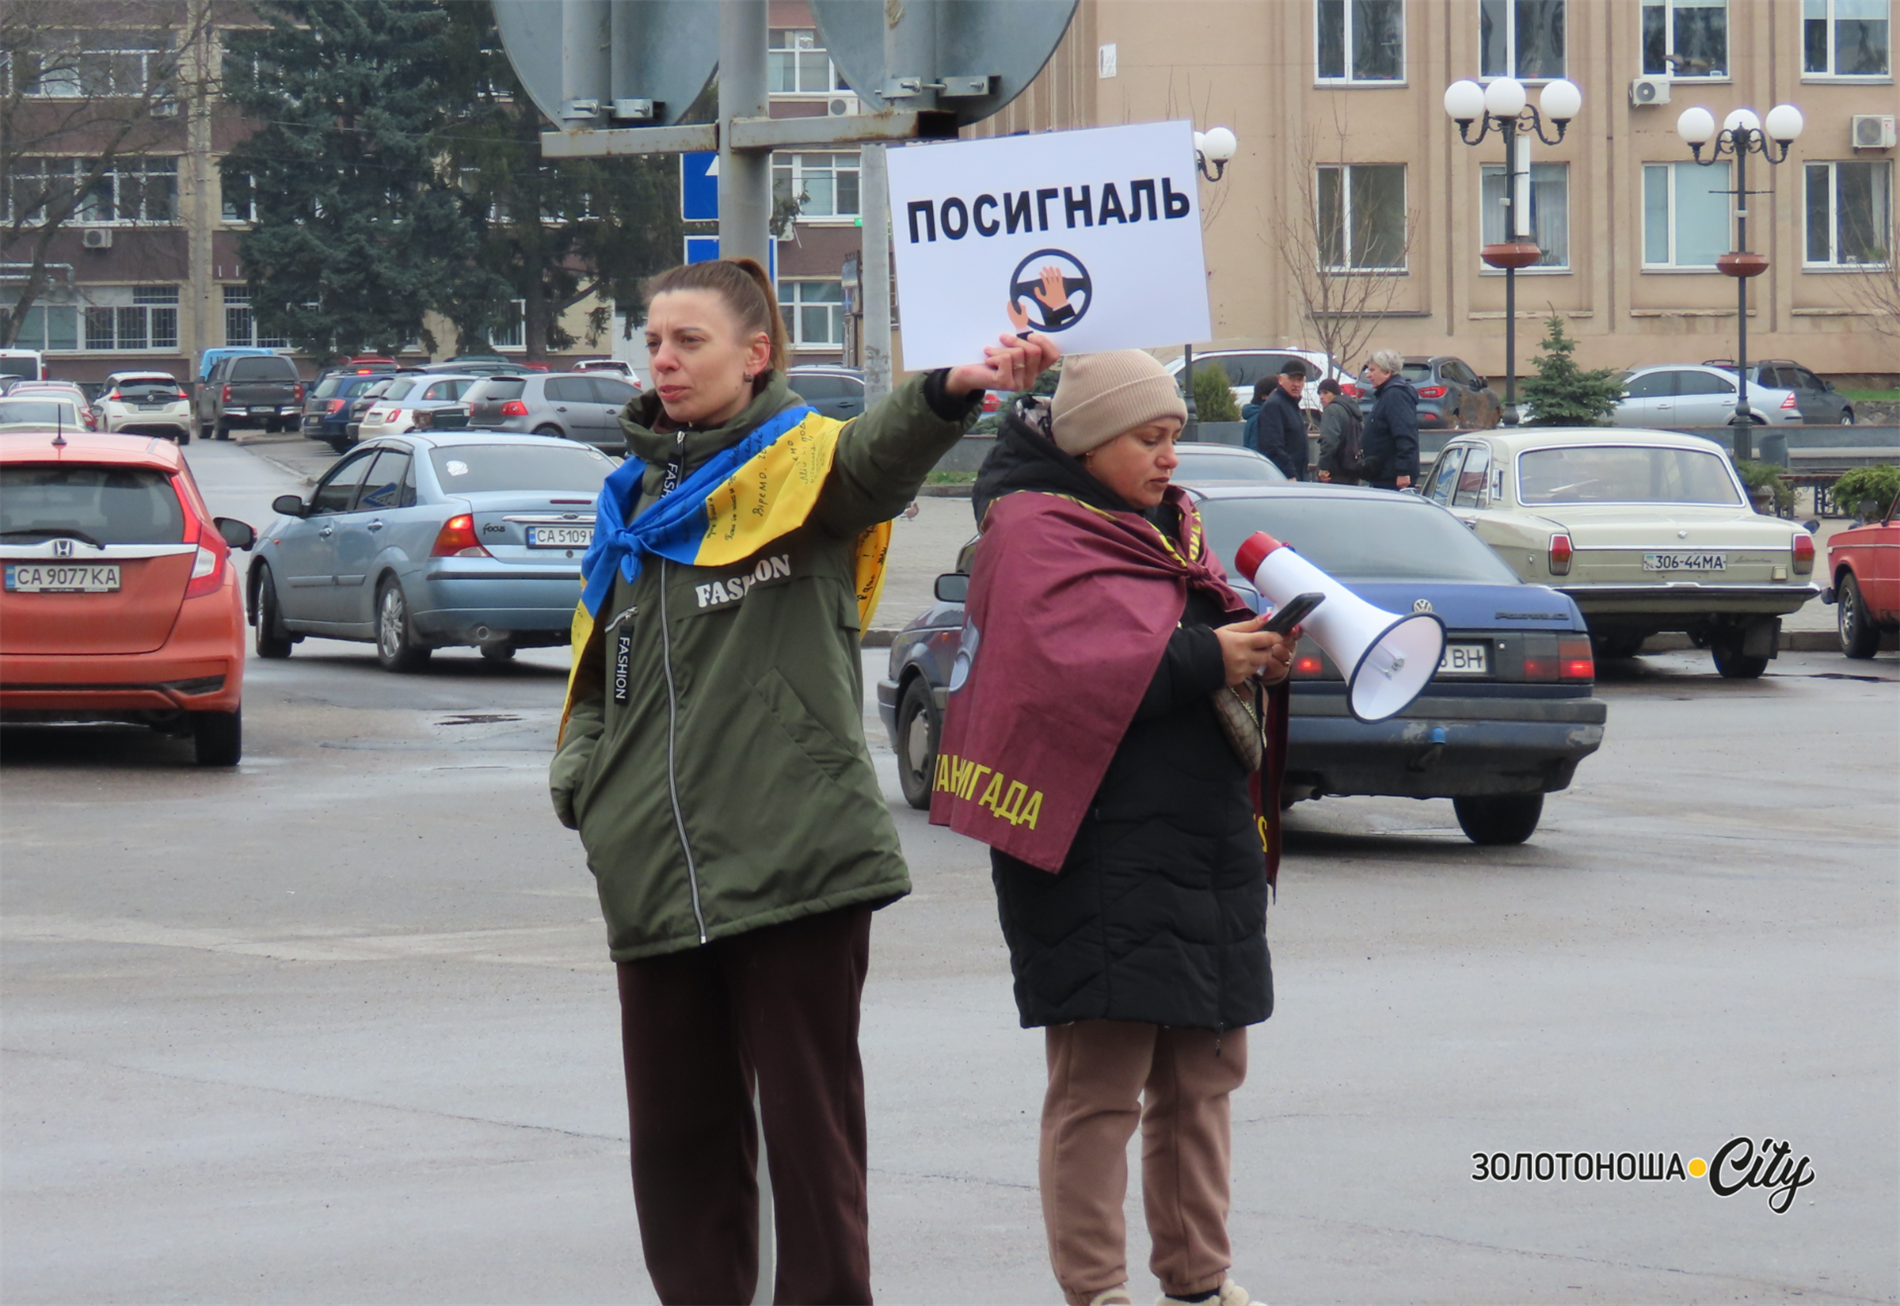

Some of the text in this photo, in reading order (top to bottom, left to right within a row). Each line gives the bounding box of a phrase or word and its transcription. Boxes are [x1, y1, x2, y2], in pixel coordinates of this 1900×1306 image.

[906, 177, 1191, 244] ПОСИГНАЛЬ
[659, 462, 679, 500] FASH
[558, 529, 587, 543] 5109
[46, 568, 88, 585] 9077
[695, 554, 791, 608] FASON
[615, 636, 630, 700] FASHION
